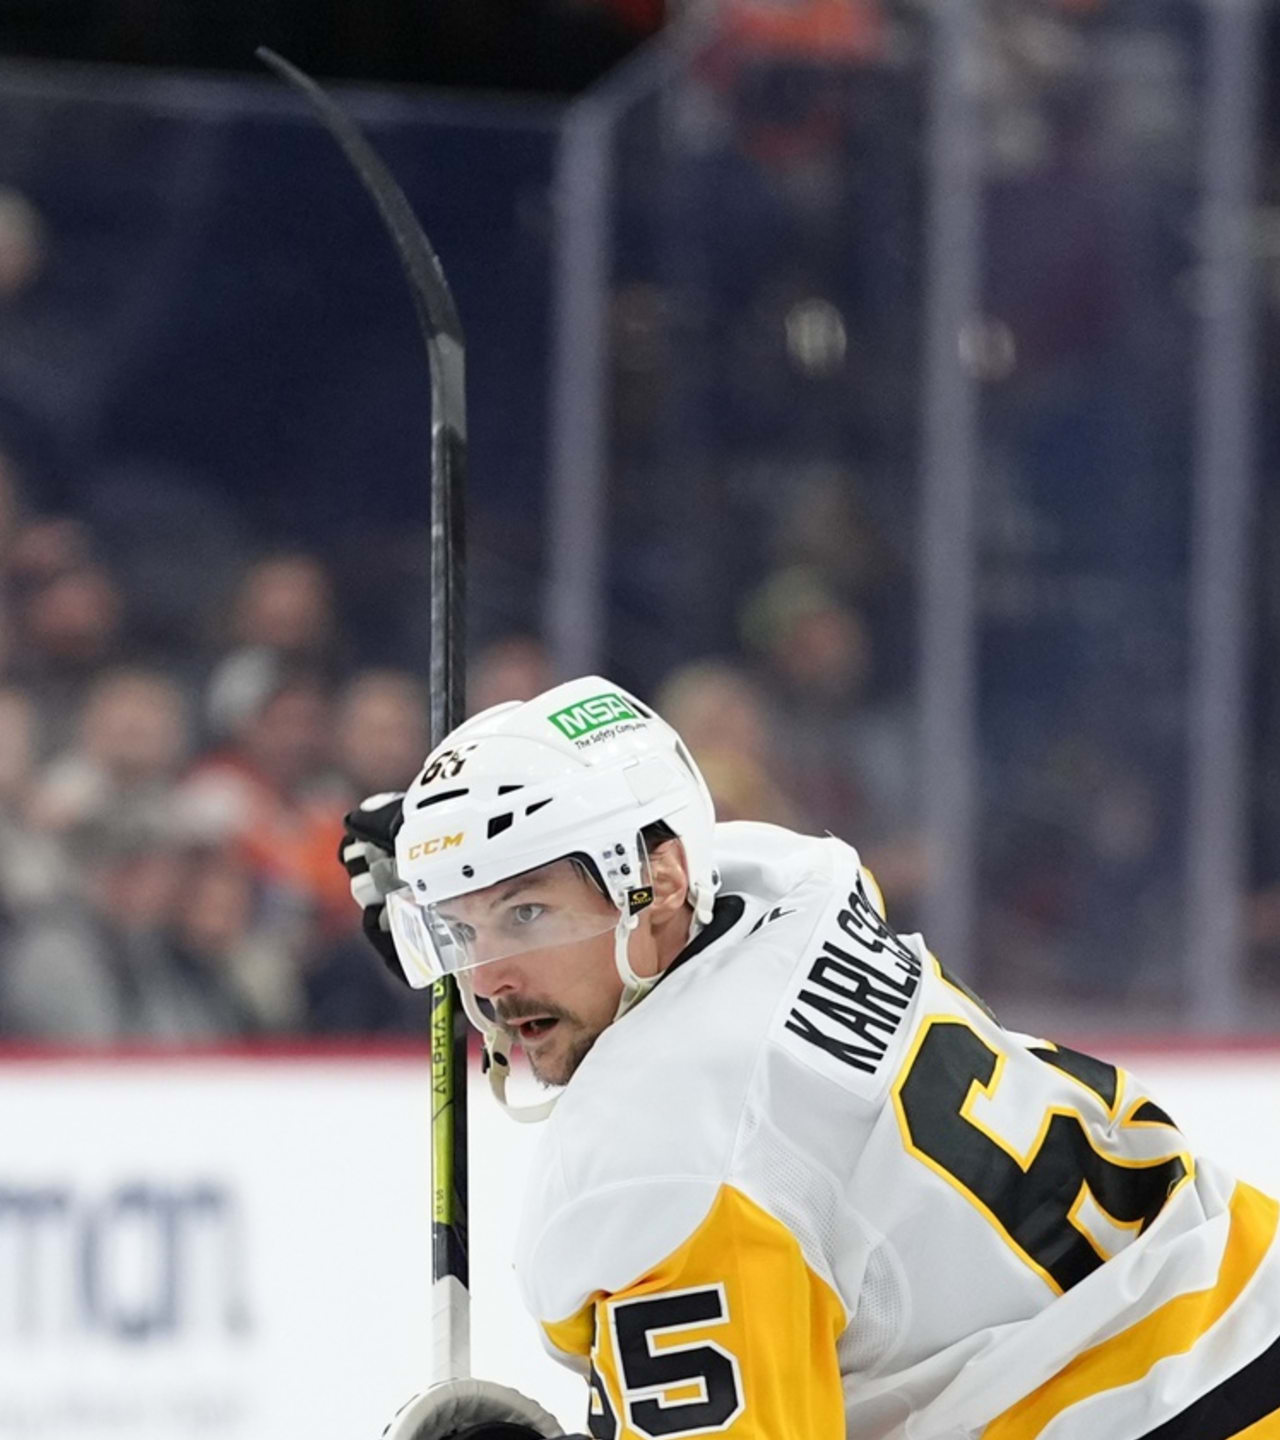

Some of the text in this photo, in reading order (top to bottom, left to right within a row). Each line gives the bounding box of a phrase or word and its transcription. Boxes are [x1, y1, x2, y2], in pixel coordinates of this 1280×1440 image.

[556, 697, 635, 736] MSA
[409, 832, 464, 861] CCM
[784, 869, 922, 1075] KARLSS
[433, 1016, 446, 1095] ALPHA
